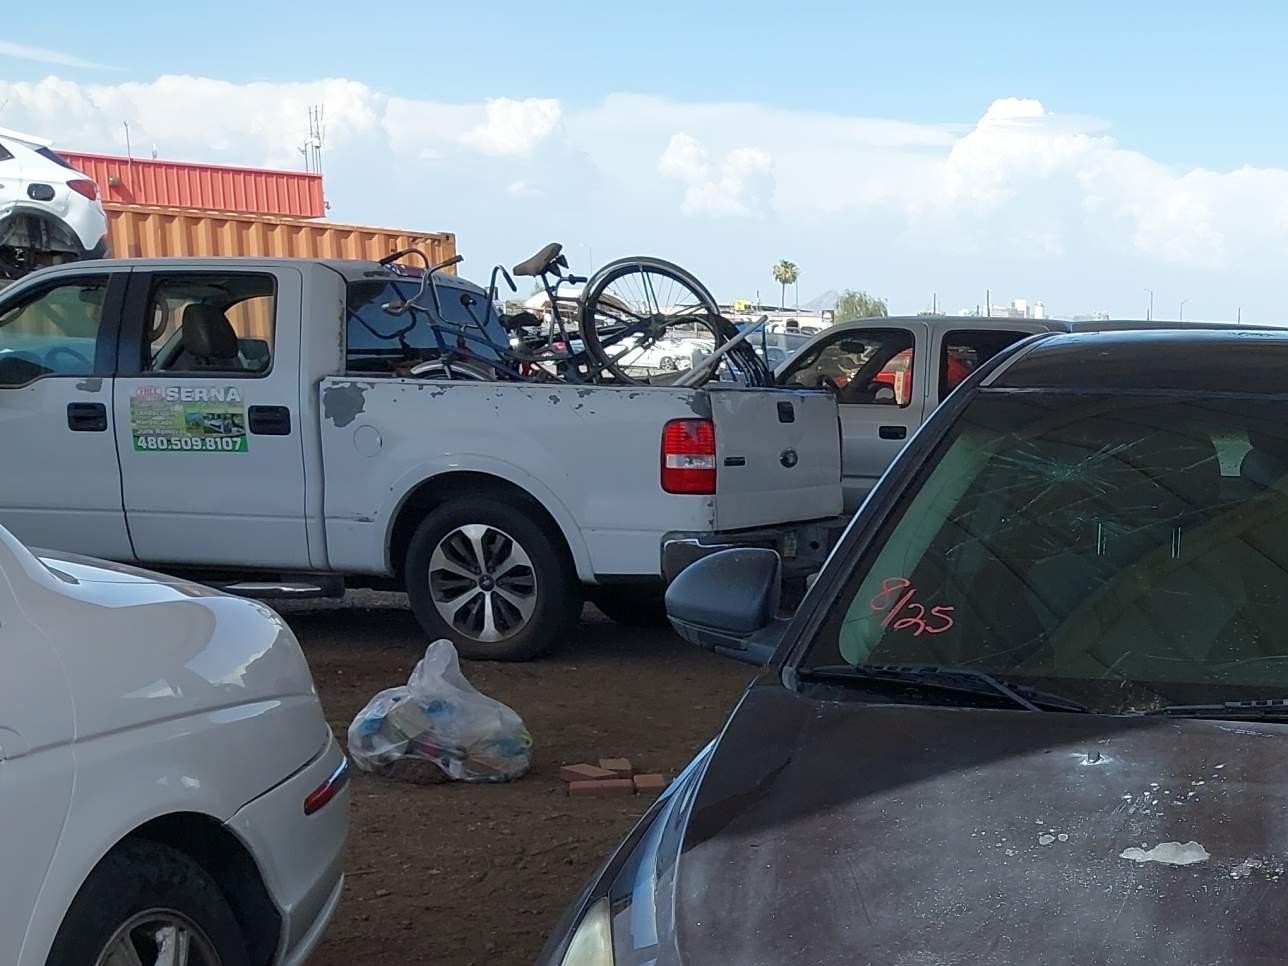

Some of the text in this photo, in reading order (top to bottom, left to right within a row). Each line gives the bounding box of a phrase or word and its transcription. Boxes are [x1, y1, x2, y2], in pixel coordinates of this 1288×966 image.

[166, 386, 241, 402] SERNA
[137, 436, 242, 450] 480.509.8107
[870, 577, 954, 636] 8/25
